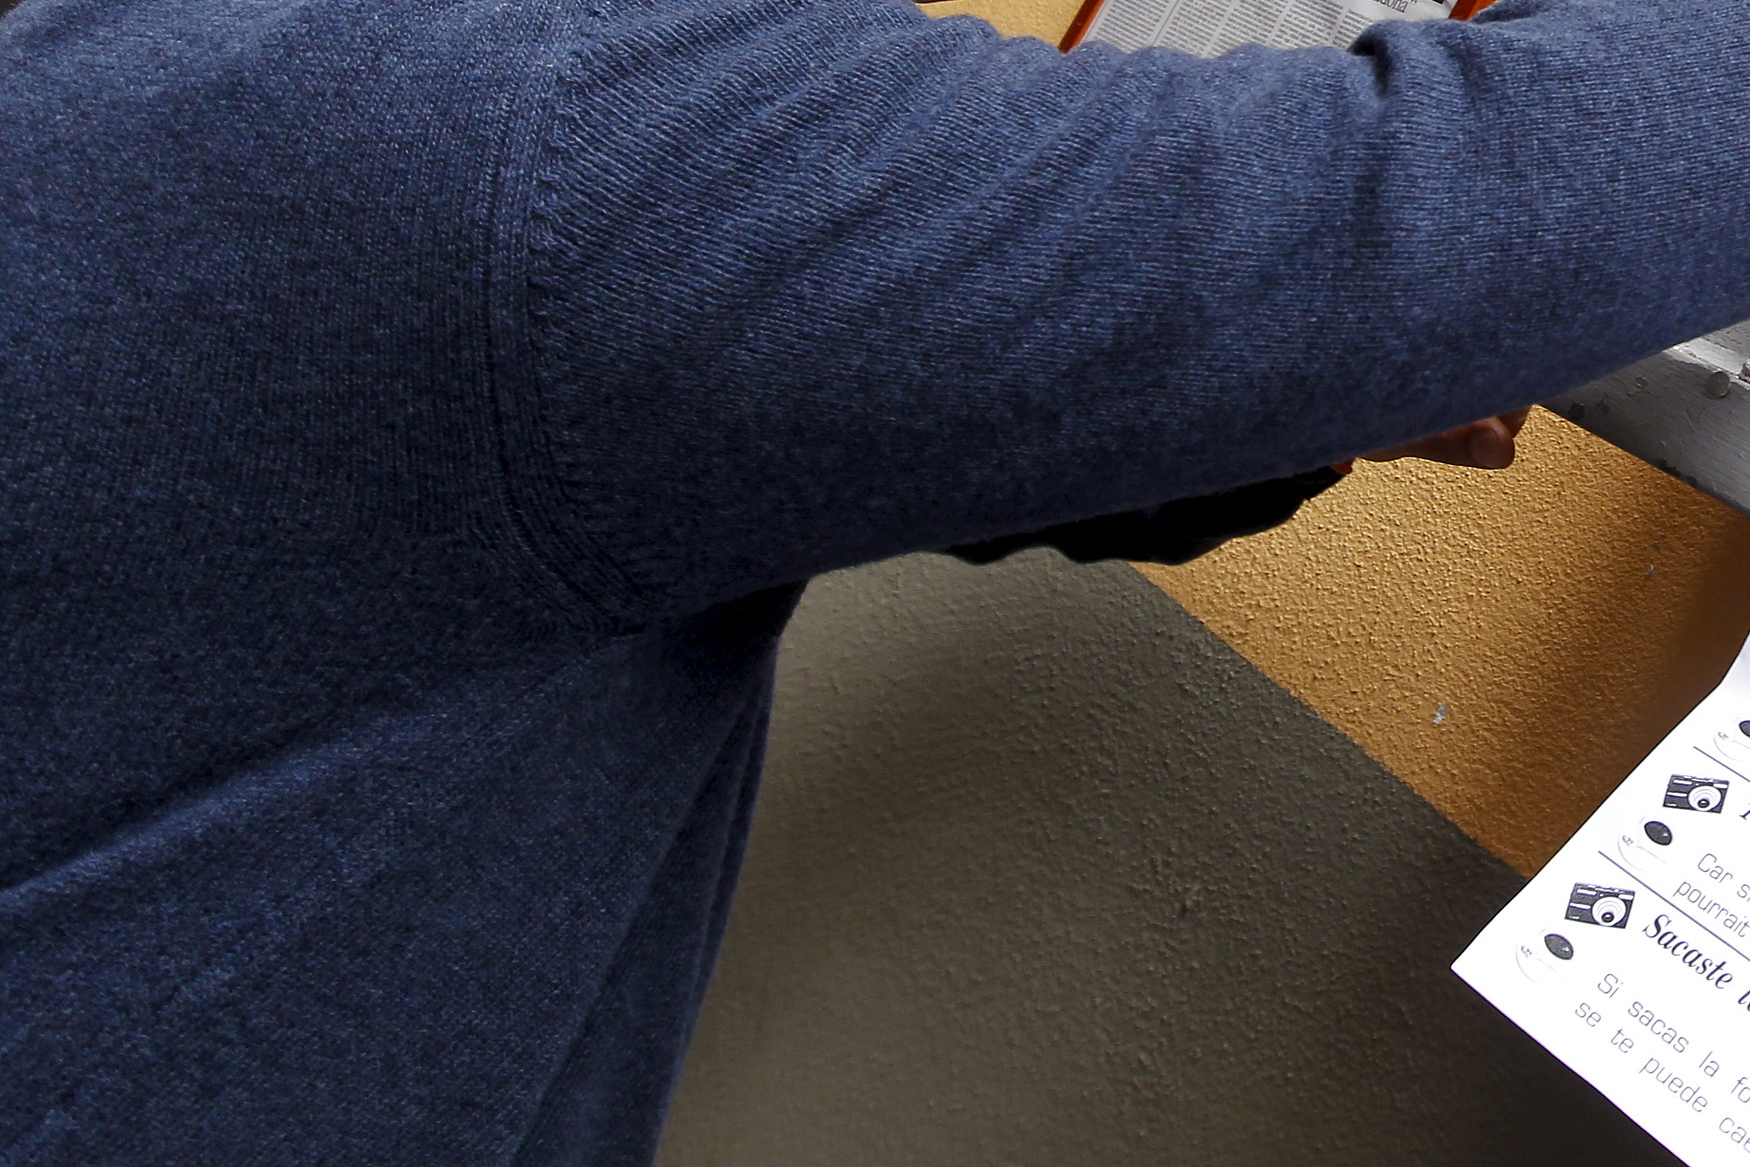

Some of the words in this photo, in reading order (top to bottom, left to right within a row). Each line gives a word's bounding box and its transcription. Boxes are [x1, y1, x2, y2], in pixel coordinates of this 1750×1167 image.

[1697, 853, 1734, 883] Car
[1672, 881, 1750, 938] pourrait
[1641, 914, 1733, 990] Sacaste
[1574, 1002, 1602, 1027] se
[1610, 1028, 1634, 1054] te
[1639, 1057, 1708, 1113] puede
[1597, 973, 1620, 998] Si
[1627, 1001, 1689, 1053] sacas
[1698, 1051, 1720, 1078] la
